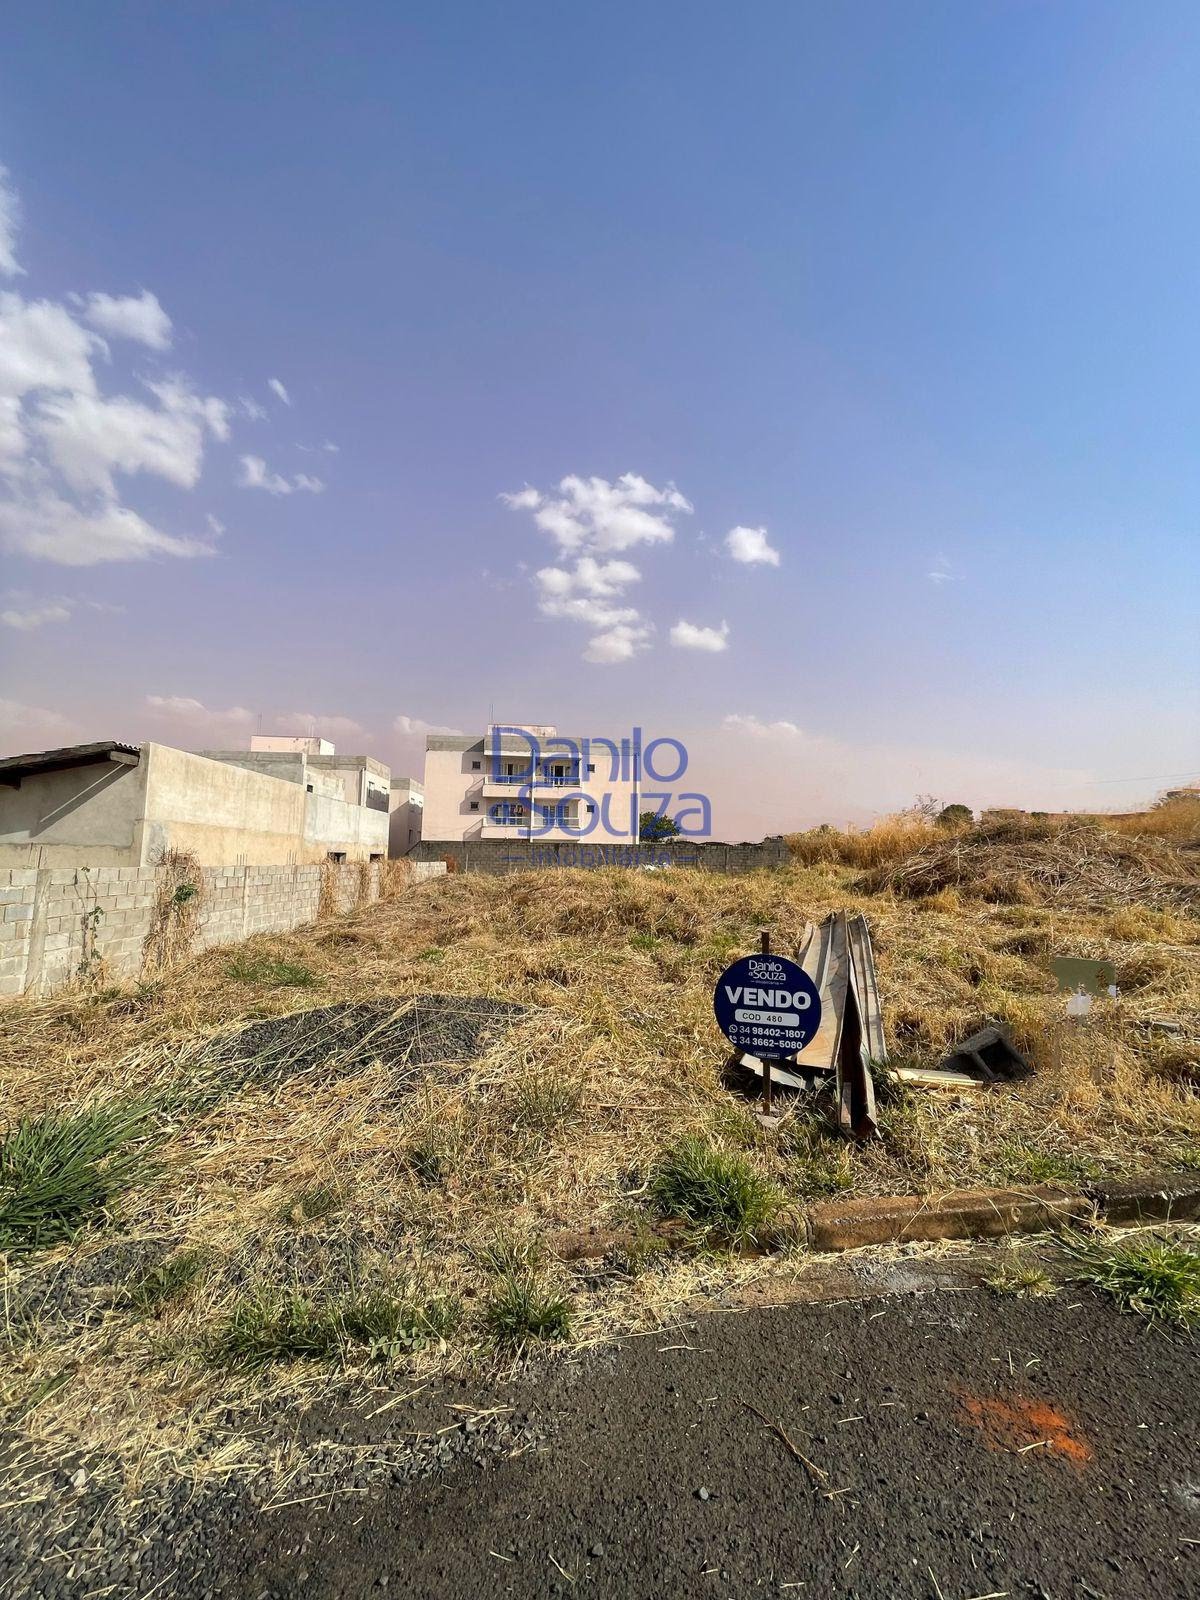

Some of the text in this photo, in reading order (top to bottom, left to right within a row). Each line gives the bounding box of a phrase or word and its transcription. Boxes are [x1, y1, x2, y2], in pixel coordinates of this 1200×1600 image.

[748, 959, 783, 972] Danilo
[724, 985, 812, 1010] VENDO
[742, 1012, 783, 1023] COD 480
[739, 1025, 806, 1039] 34 98402-1807
[739, 1036, 803, 1050] 34 3662-5080
